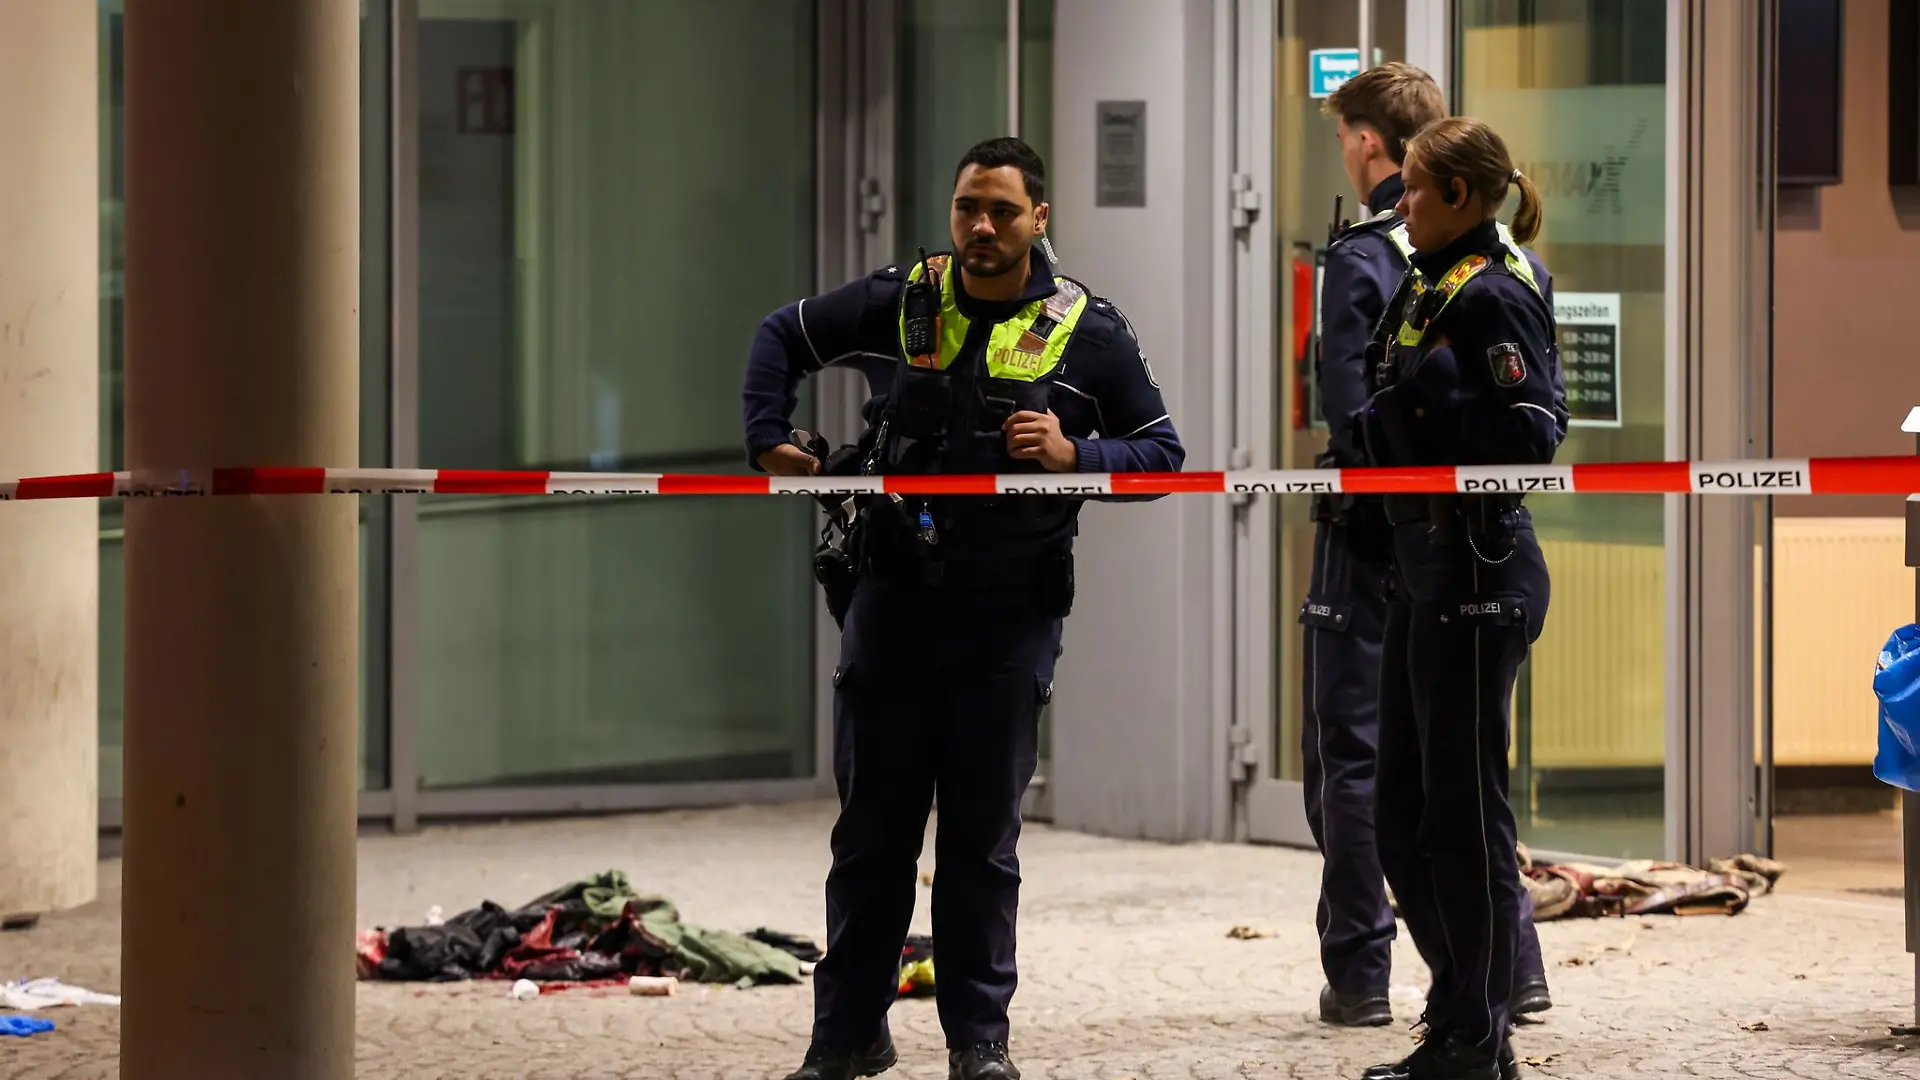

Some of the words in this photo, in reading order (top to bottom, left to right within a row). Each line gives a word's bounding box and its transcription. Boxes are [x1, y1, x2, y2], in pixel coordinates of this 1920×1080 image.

[993, 347, 1043, 372] POLIZEI
[1464, 477, 1565, 491] POLIZEI
[1699, 471, 1801, 488] POLIZEI
[1460, 602, 1501, 615] POLIZEI
